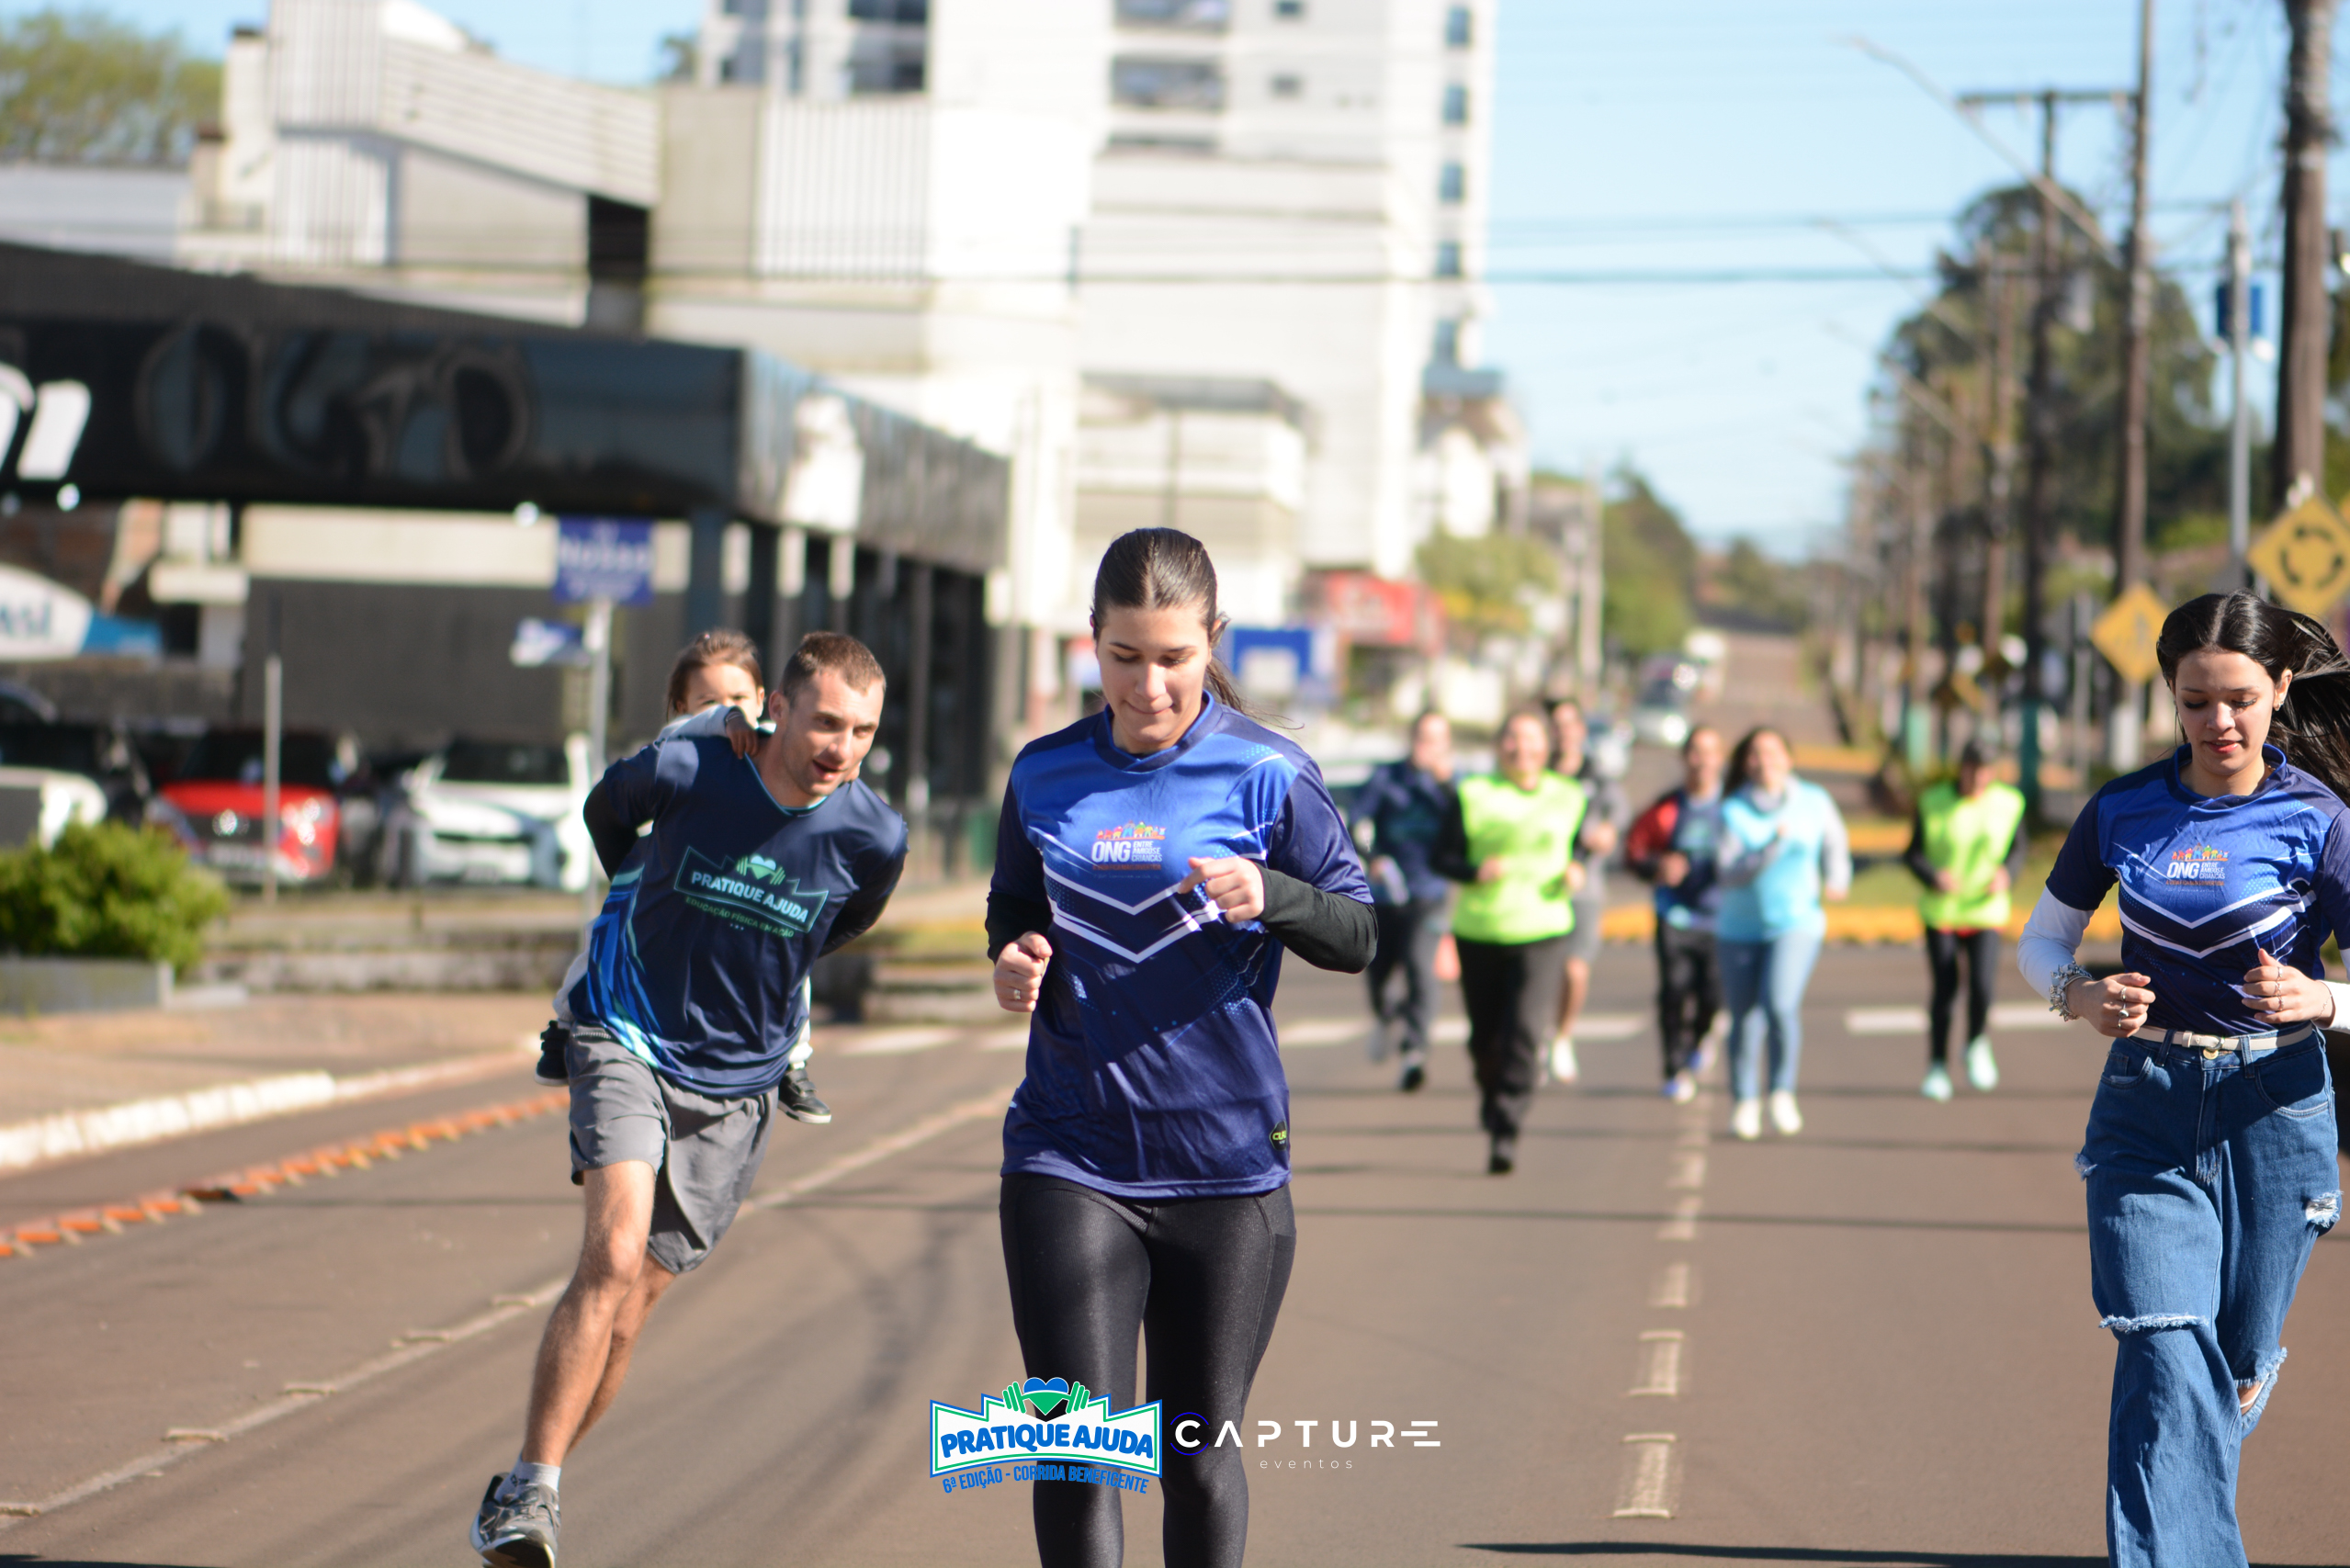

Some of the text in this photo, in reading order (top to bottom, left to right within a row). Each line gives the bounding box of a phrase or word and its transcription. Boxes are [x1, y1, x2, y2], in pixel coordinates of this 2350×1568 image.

[1091, 840, 1131, 863] ONG
[2166, 862, 2200, 879] ONG
[692, 872, 809, 923] PRATIQUE AJUDA
[685, 897, 794, 938] EDUCAÇÃO FÍSICA EM AÇÃO
